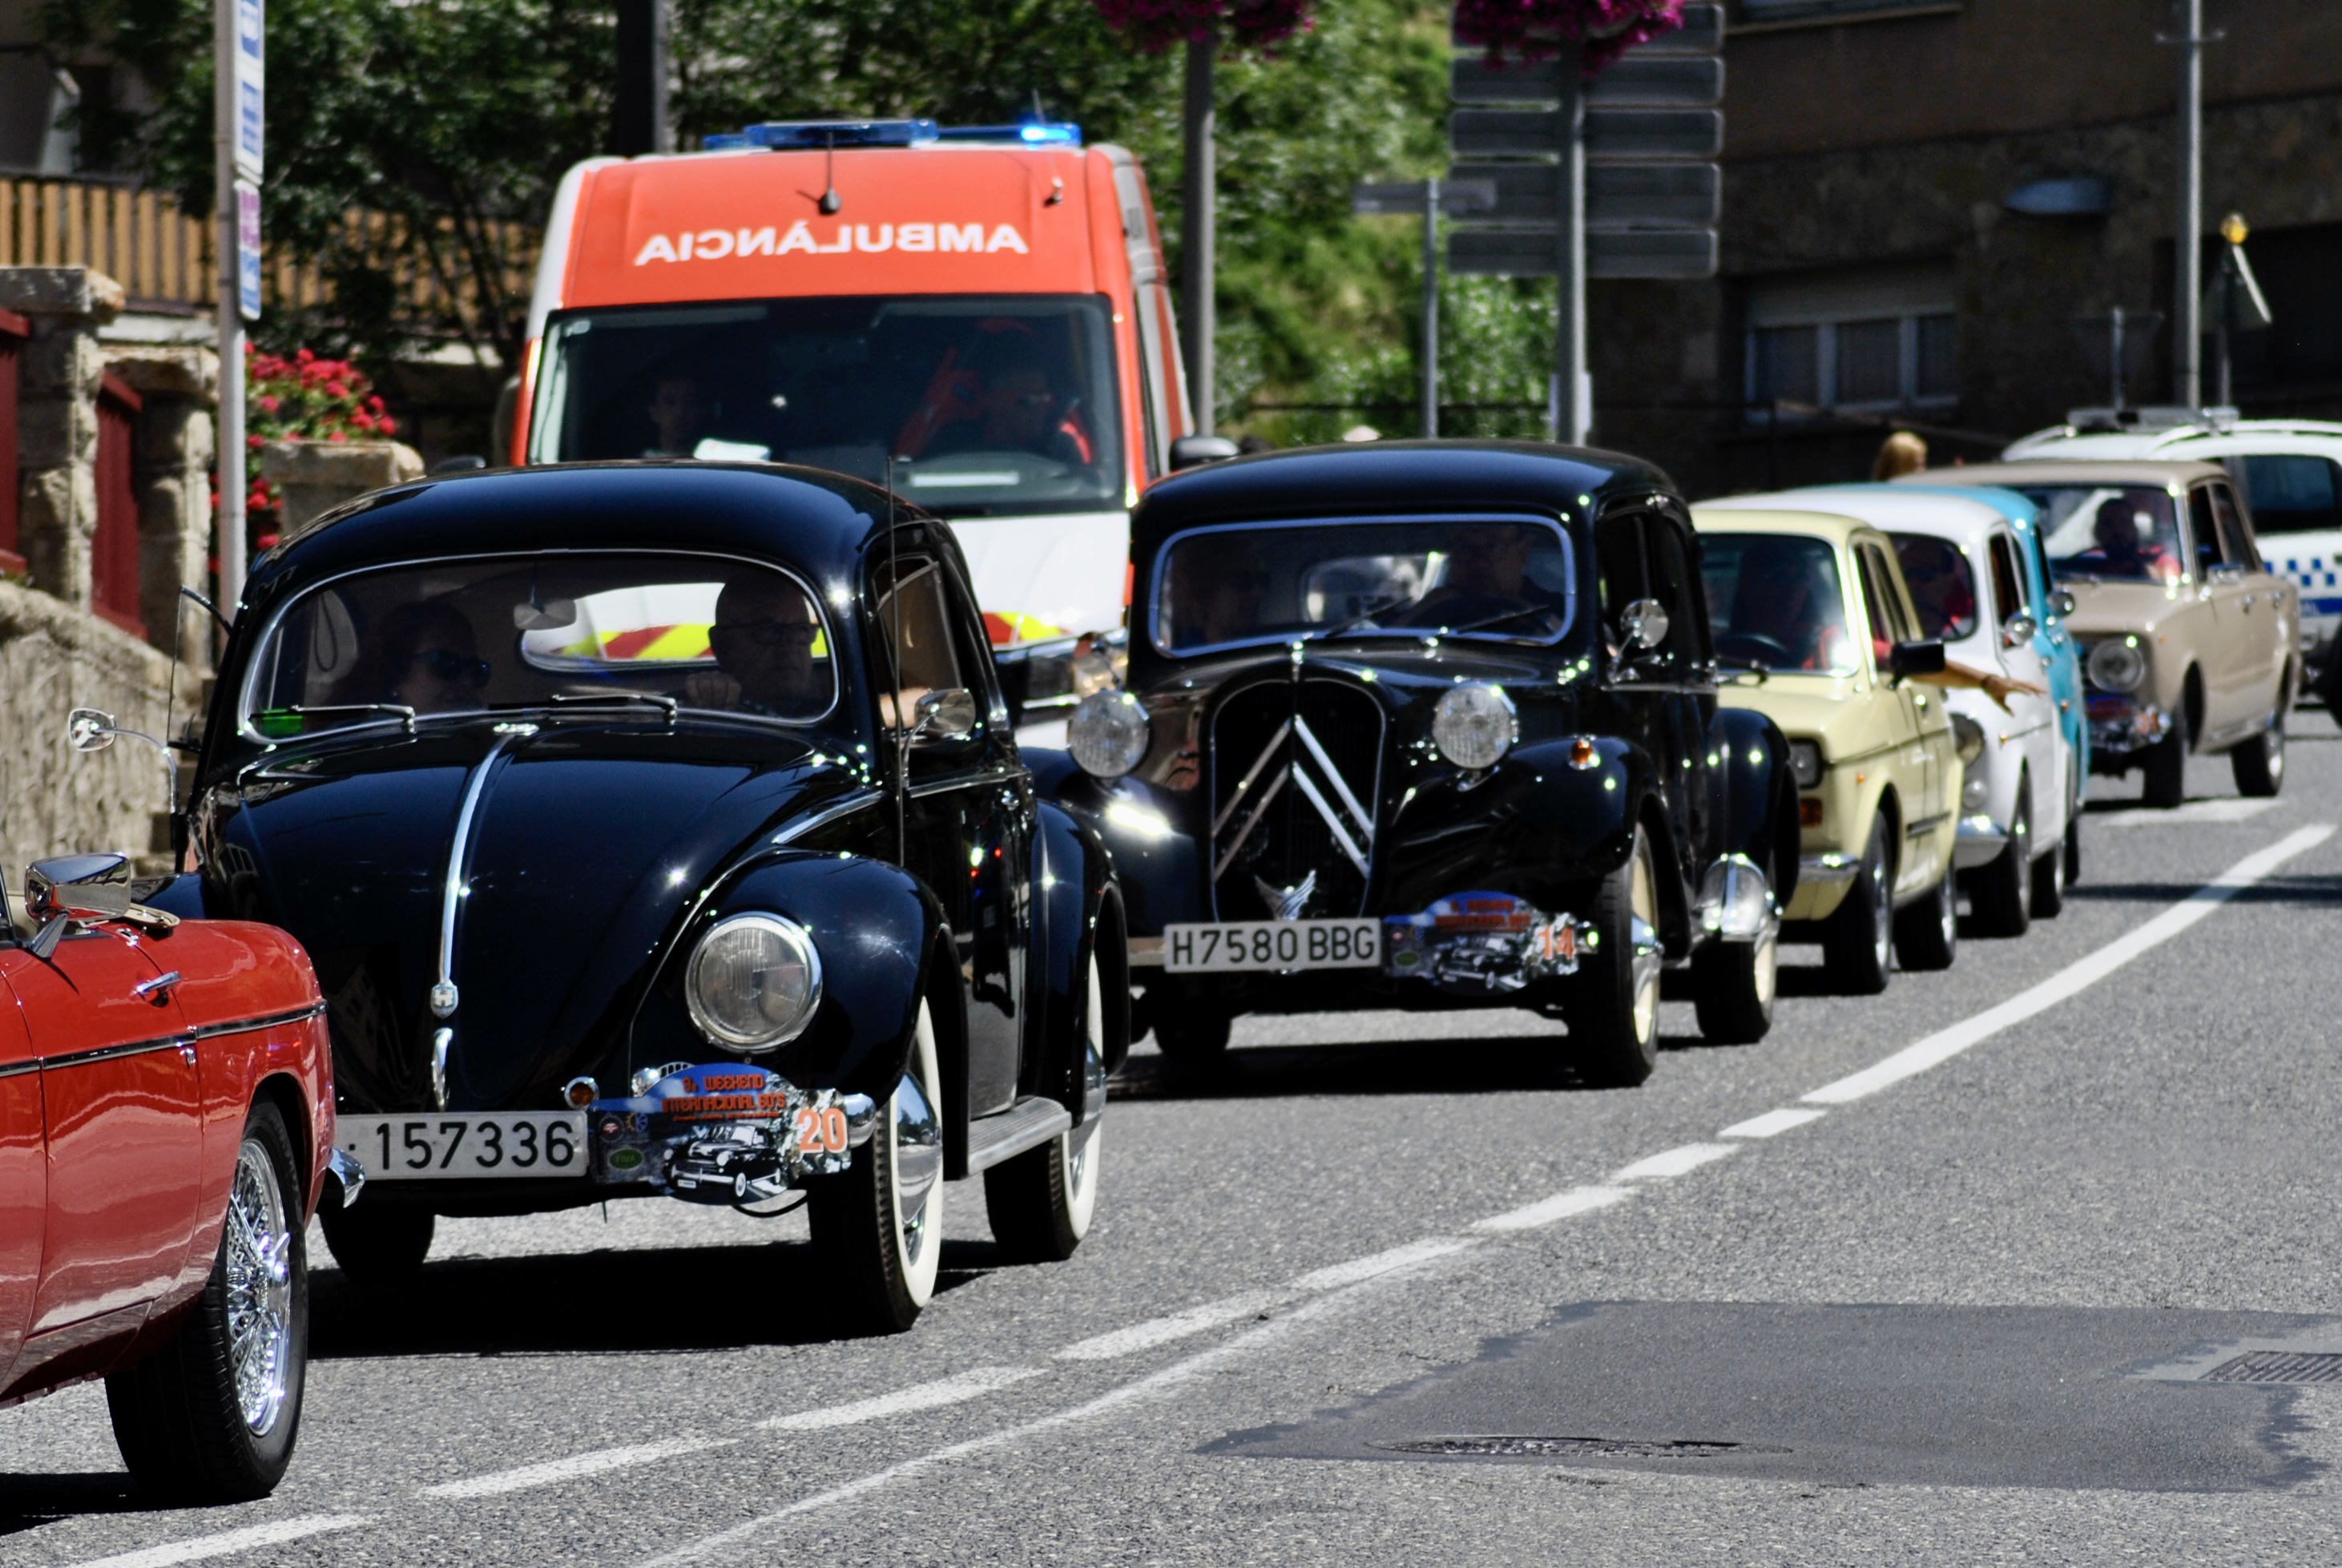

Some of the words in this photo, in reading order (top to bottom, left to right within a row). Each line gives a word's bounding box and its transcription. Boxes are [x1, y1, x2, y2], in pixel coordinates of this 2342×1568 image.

[1172, 927, 1298, 965] H7580
[1308, 926, 1374, 961] BBG
[1539, 925, 1575, 960] 14
[703, 1074, 765, 1091] WEEKEND
[662, 1094, 756, 1112] INTERNACIONAL
[796, 1107, 848, 1153] 20
